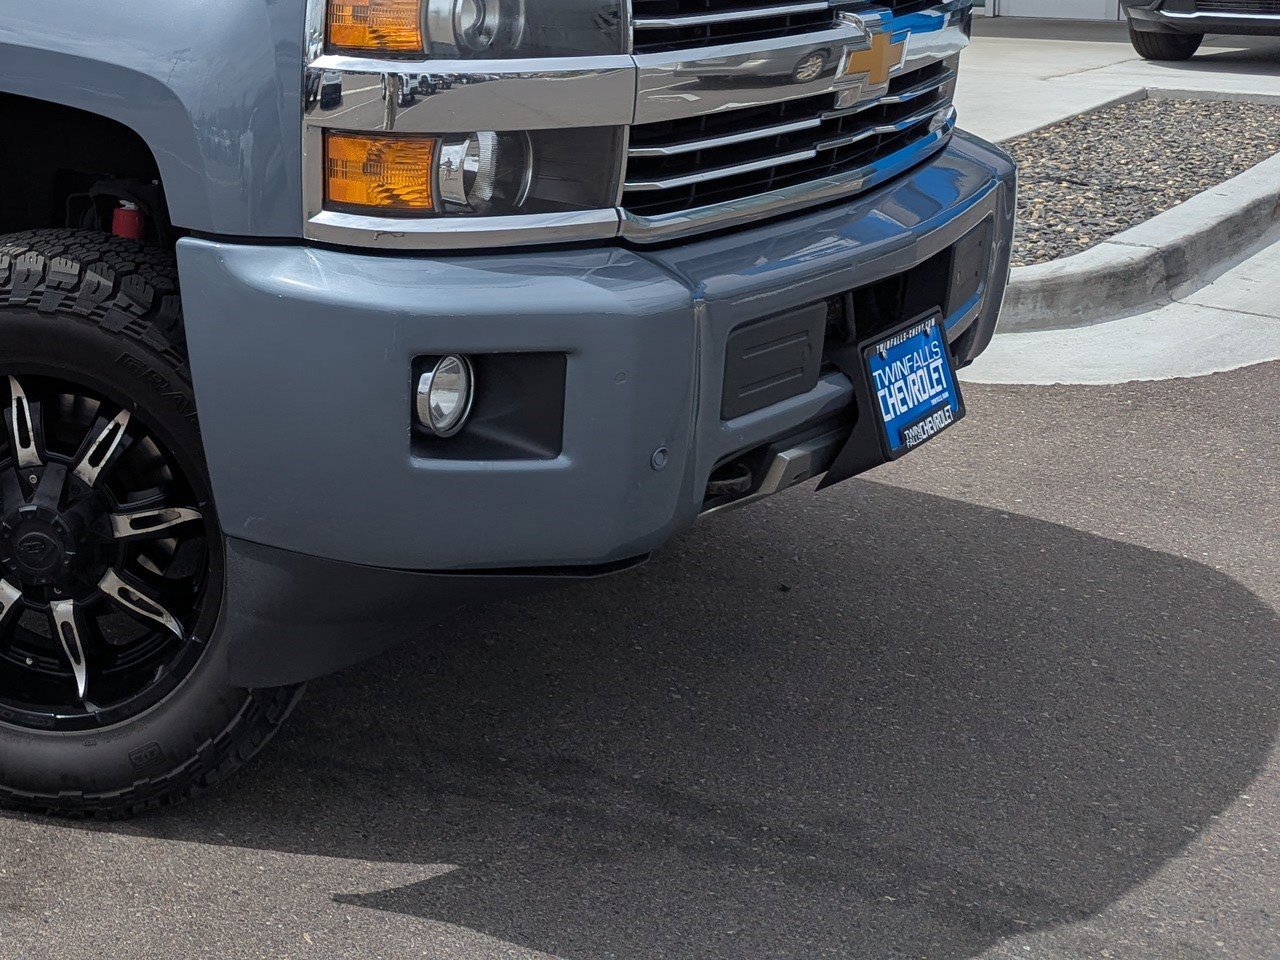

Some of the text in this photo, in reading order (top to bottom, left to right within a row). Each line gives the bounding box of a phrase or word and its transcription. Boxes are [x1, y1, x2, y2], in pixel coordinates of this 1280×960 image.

[872, 341, 941, 390] TWINFALLS
[877, 358, 947, 422] CHEVROLET
[919, 405, 954, 439] CHEVROLET
